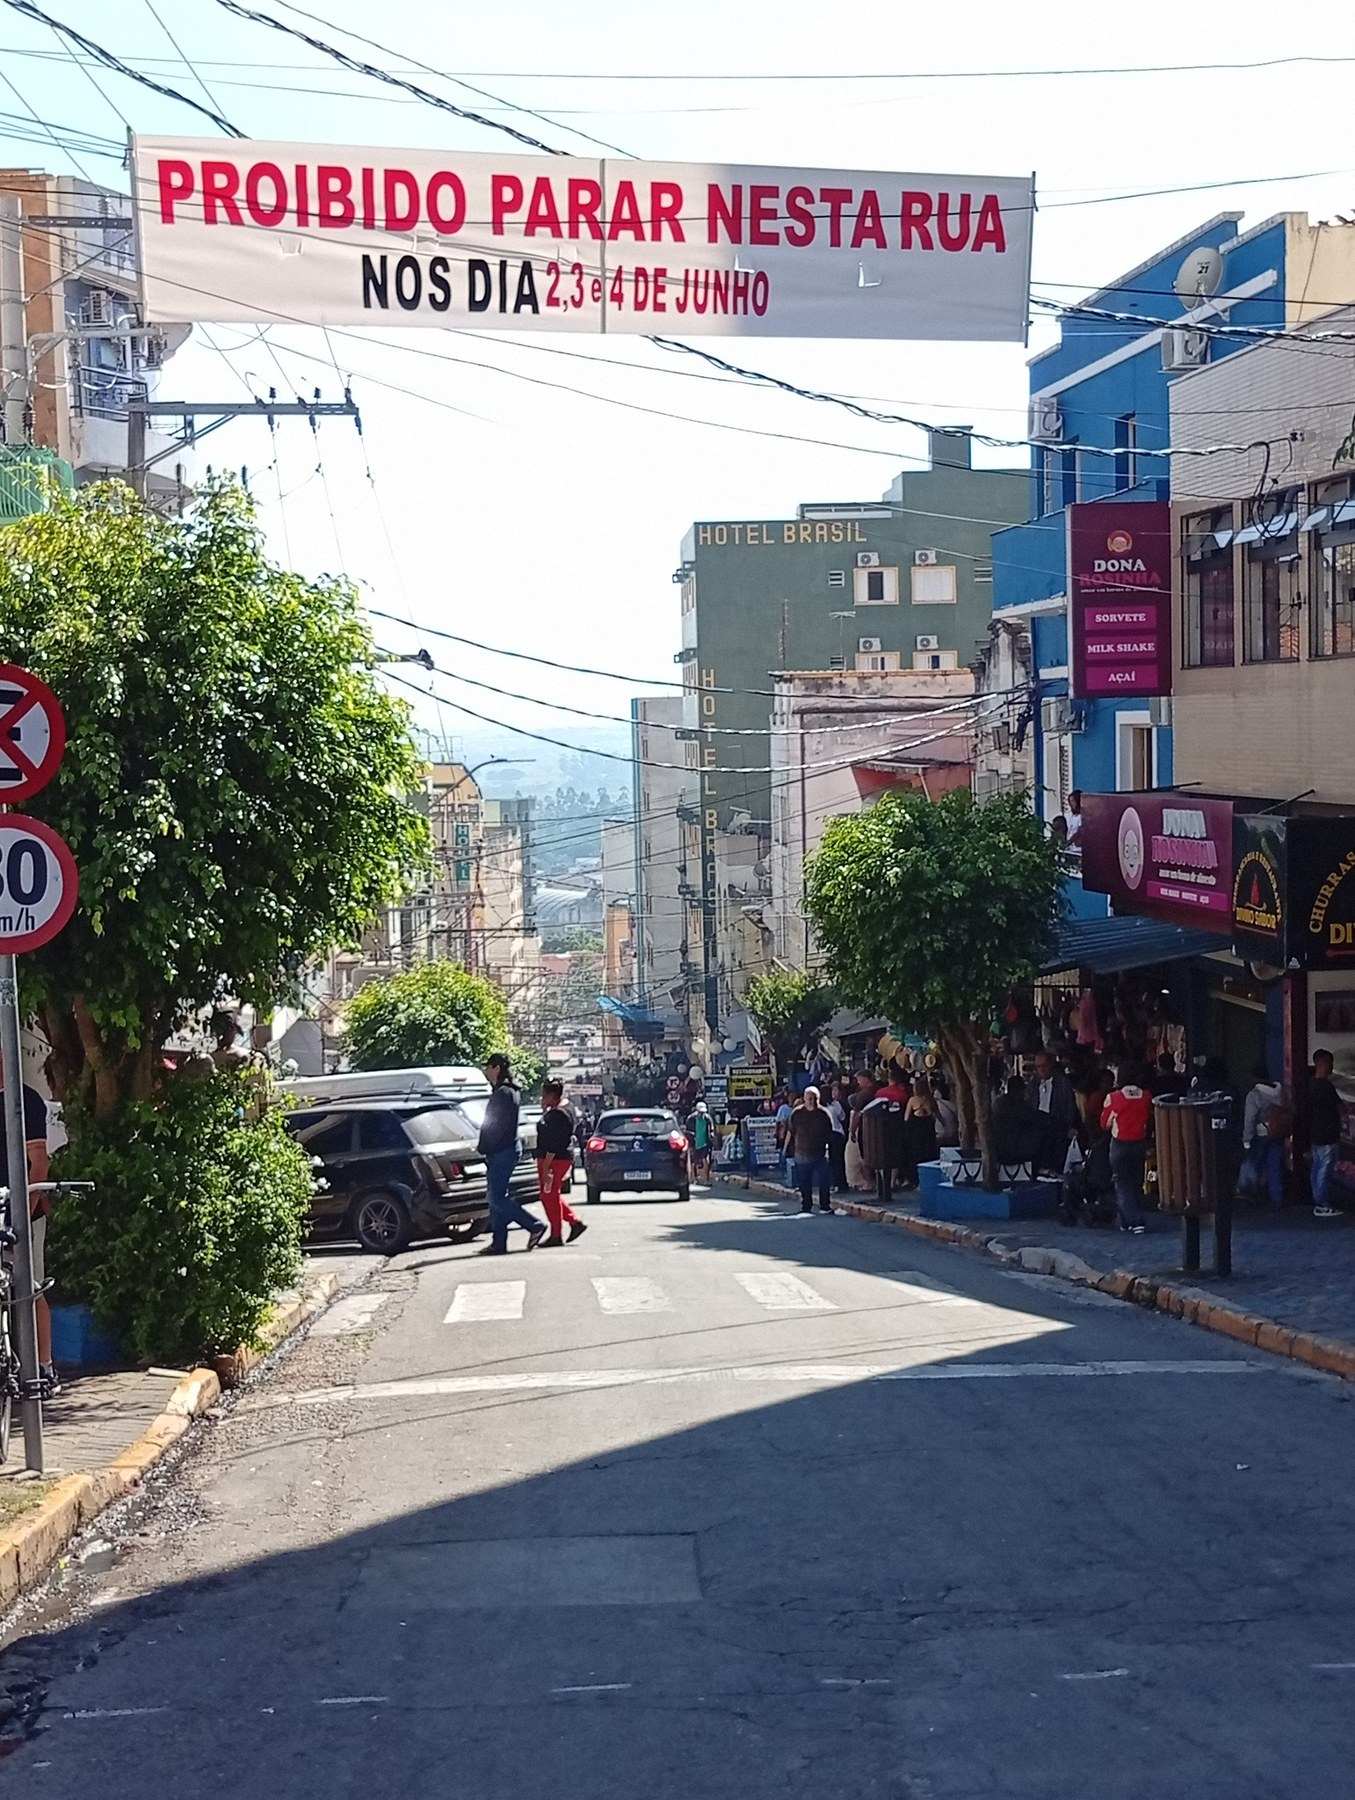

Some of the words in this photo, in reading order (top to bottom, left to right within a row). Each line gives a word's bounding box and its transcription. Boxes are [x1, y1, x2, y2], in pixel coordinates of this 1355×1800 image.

[156, 158, 468, 236] PROIBIDO
[490, 173, 687, 244] PARAR
[708, 183, 888, 249] NESTA
[900, 190, 1007, 253] RUA
[362, 254, 452, 311] NOS
[468, 258, 540, 315] DIA
[590, 278, 603, 303] e
[610, 264, 624, 311] 4
[633, 266, 668, 314] DE
[675, 268, 770, 317] JUNHO
[699, 524, 775, 546] HOTEL
[783, 521, 868, 544] BRASIL
[1093, 558, 1147, 573] DONA
[1079, 572, 1162, 587] ROSINHA
[1095, 613, 1146, 623] SORVETE
[1087, 644, 1116, 654] MILK
[1116, 642, 1156, 653] SHAKE
[1108, 670, 1136, 684] AÇAÍ
[1162, 808, 1206, 838] DONA
[0, 838, 48, 906] 0
[1329, 922, 1355, 944] DI
